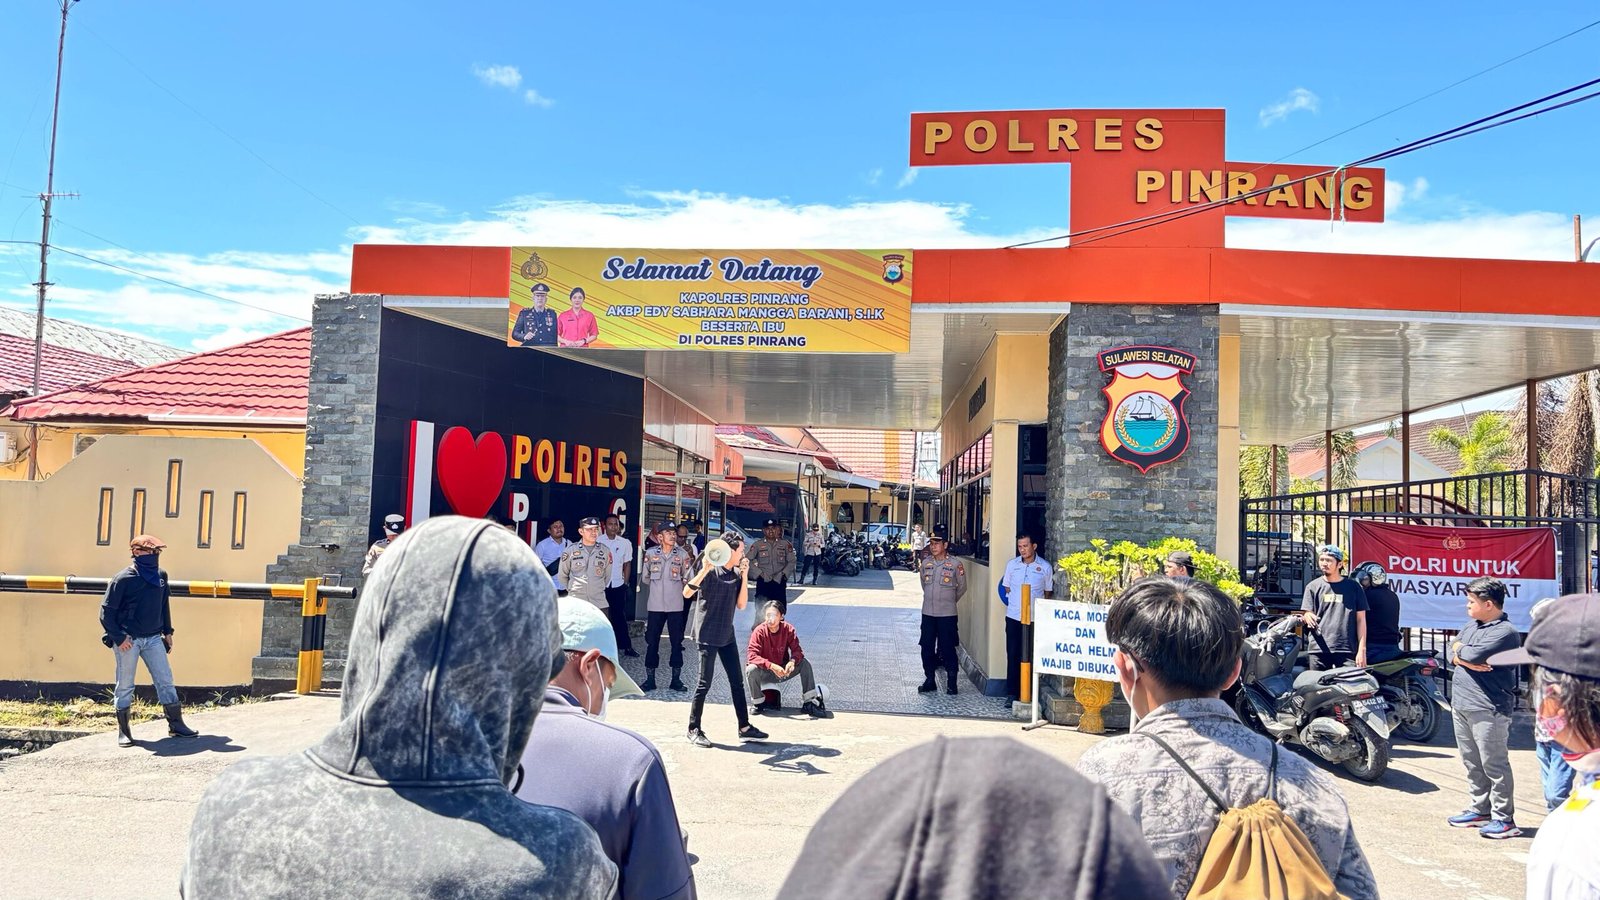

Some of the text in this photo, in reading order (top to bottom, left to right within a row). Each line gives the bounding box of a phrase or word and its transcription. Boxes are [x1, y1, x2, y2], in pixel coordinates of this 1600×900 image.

[924, 118, 1164, 154] POLRES
[1136, 169, 1373, 210] PINRANG
[602, 257, 823, 289] Selamat Datang
[680, 292, 810, 305] KAPOLRES PINRANG
[606, 305, 884, 321] AKBP EDY SABHARA MANGGA BARANI, S.I.K
[701, 321, 785, 333] BESERTA IBU
[679, 335, 806, 347] DI POLRES PINRANG
[1104, 351, 1191, 369] SULAWESI SELATAN
[510, 434, 628, 490] POLRES
[1388, 555, 1520, 576] POLRI UNTUK
[1388, 578, 1521, 599] MASYARAT
[1054, 608, 1108, 622] KACA MOB
[1075, 627, 1096, 639] DAN
[1055, 642, 1116, 658] KACA HELM
[1041, 657, 1117, 675] WAJIB DIBUKA
